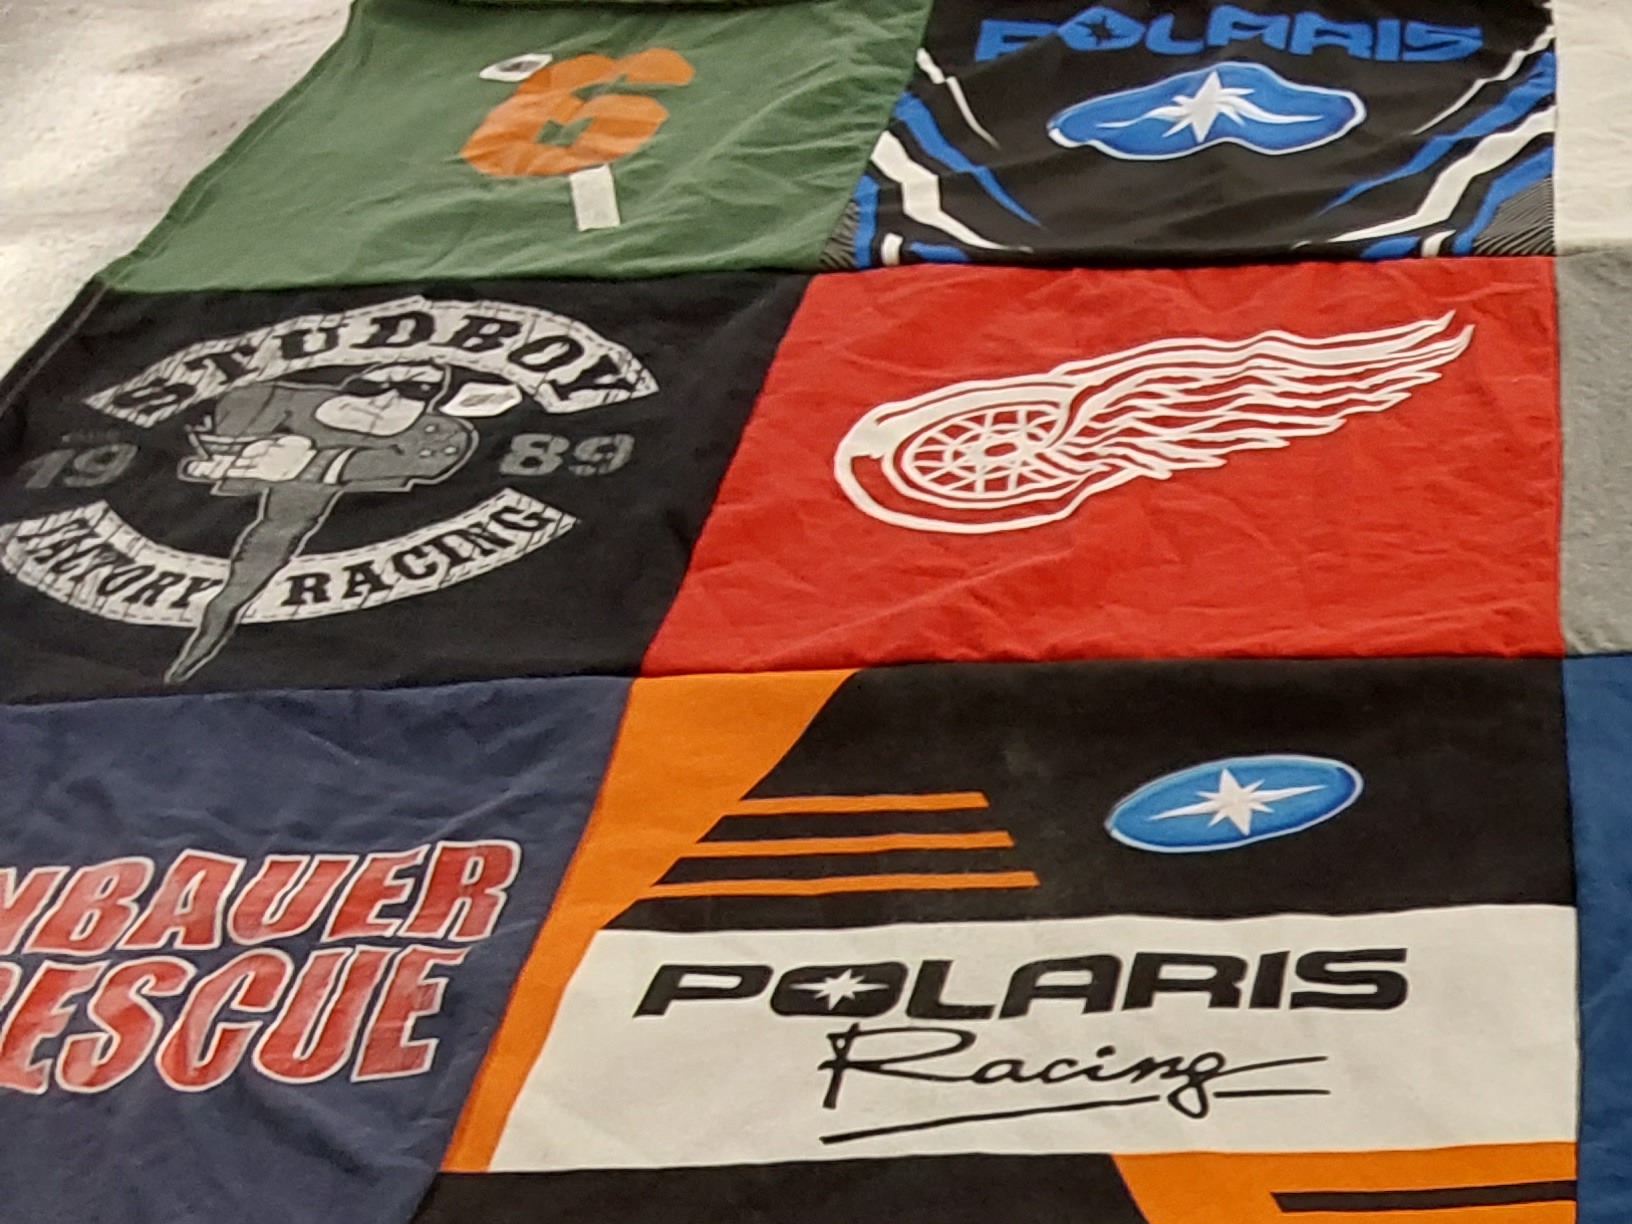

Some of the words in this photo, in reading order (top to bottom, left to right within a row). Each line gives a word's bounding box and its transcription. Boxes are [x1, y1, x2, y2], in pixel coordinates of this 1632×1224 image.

[975, 5, 1484, 61] POLARIS
[459, 47, 696, 177] 6
[110, 311, 642, 418] STUDBOY
[500, 433, 636, 477] 89
[280, 506, 557, 606] RACING
[634, 948, 1409, 1020] POLARIS
[819, 1023, 1328, 1119] Racing
